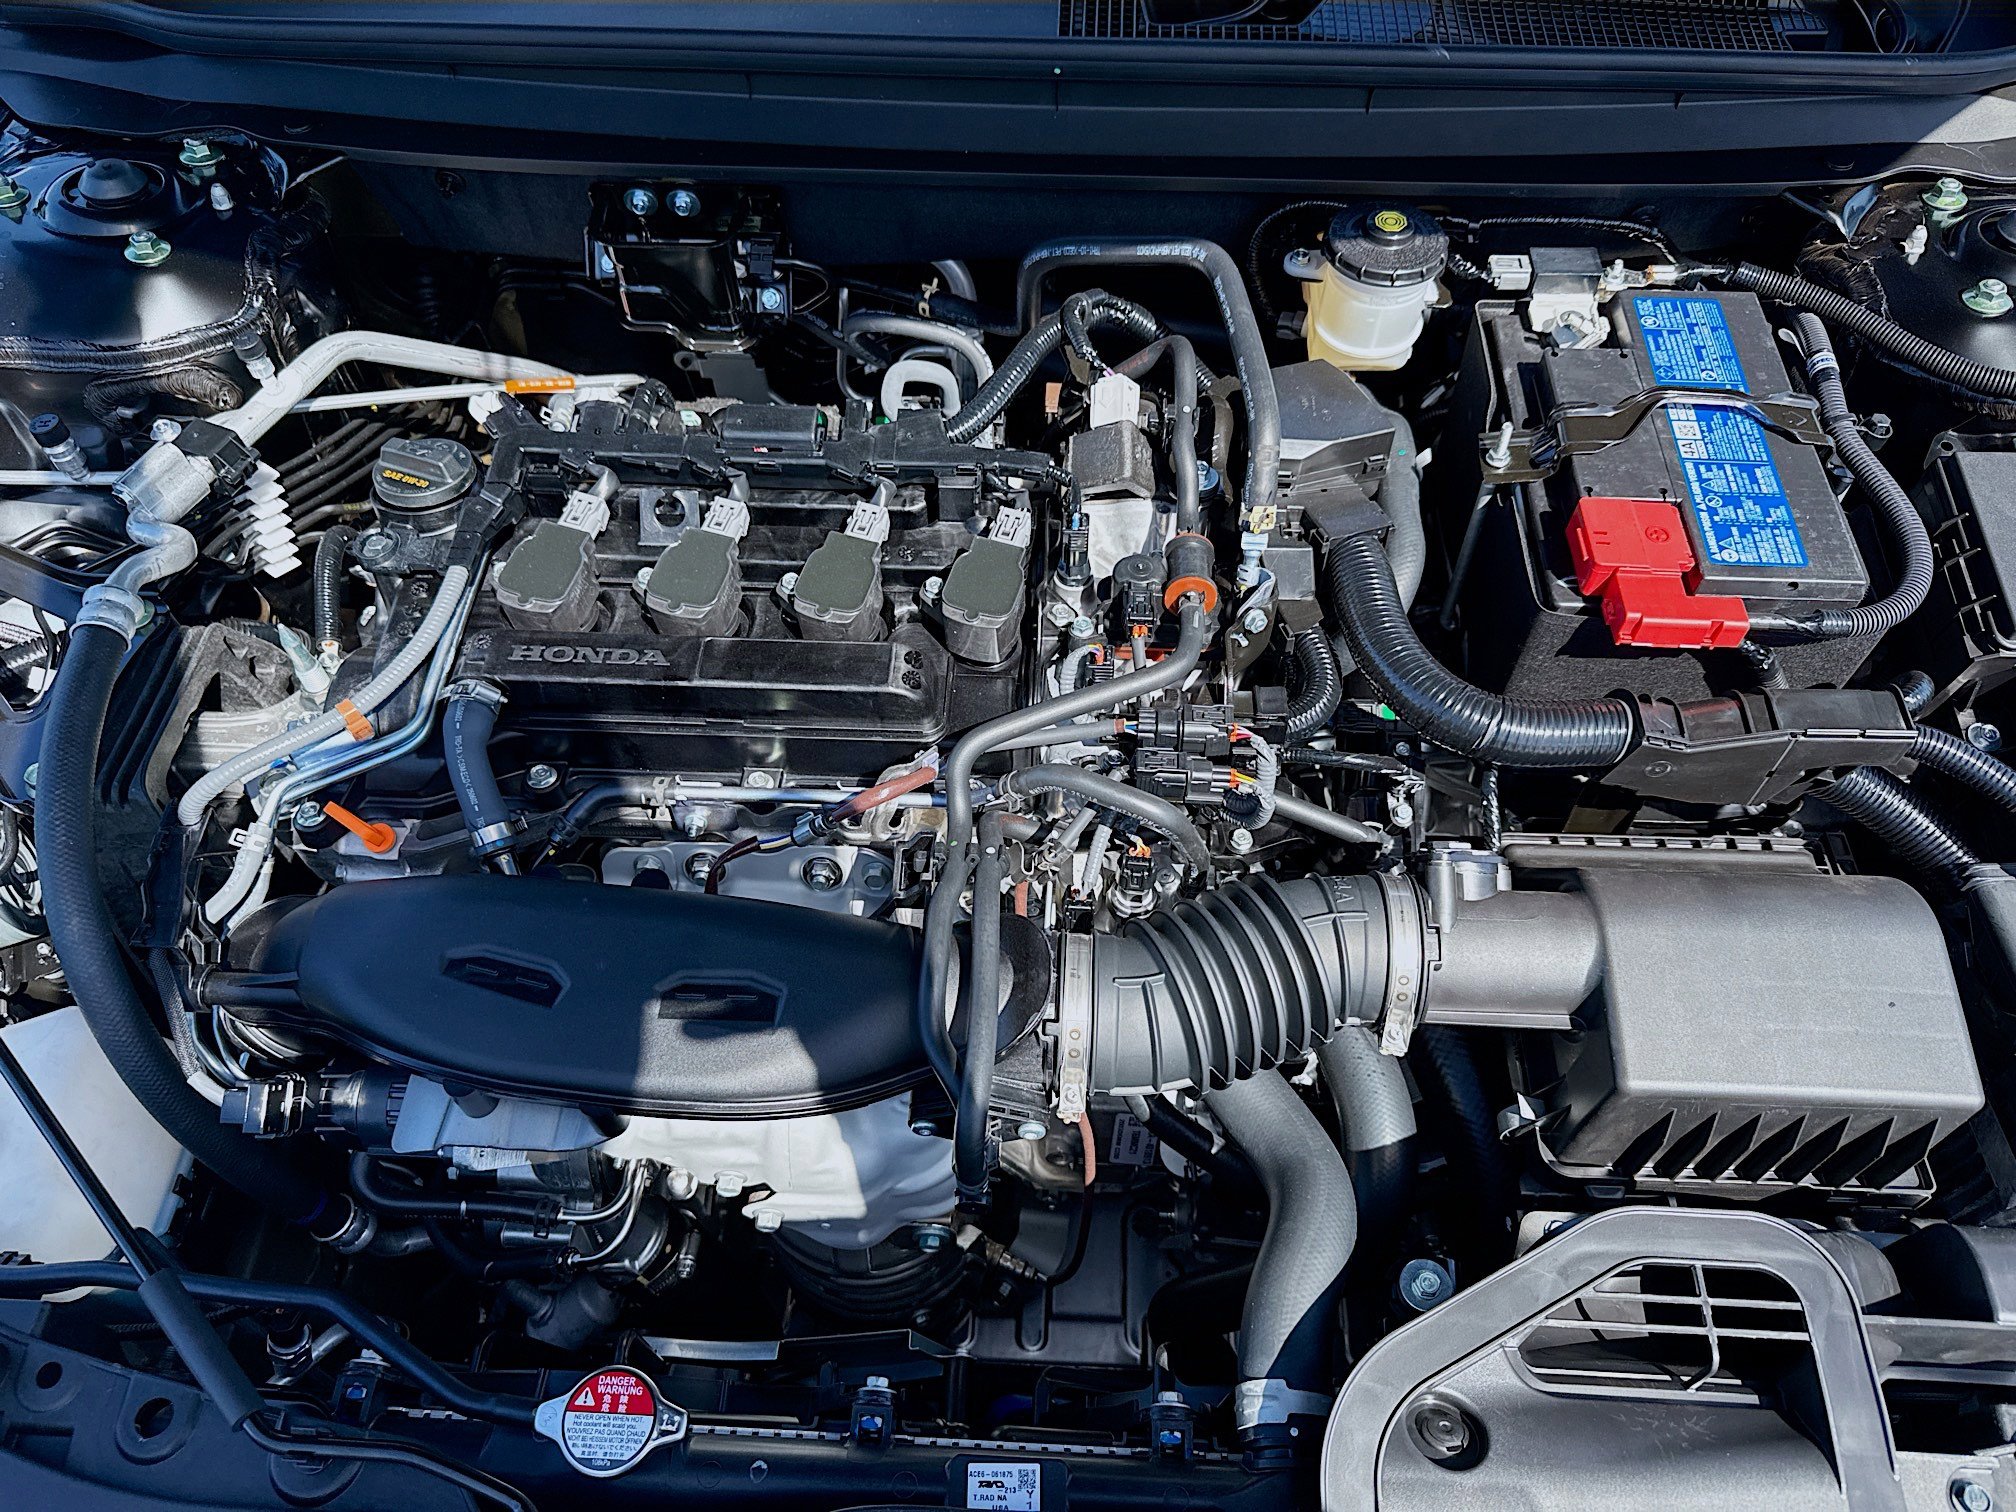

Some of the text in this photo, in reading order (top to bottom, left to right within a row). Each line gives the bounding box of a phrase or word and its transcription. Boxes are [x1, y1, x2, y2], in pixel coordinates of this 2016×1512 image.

[1680, 442, 1696, 456] 4A
[383, 469, 403, 481] SAE
[402, 475, 430, 488] 0W-20
[508, 644, 670, 666] HONDA
[598, 1375, 636, 1386] DANGER
[597, 1385, 643, 1396] WARNUNG
[1026, 1490, 1034, 1498] Y
